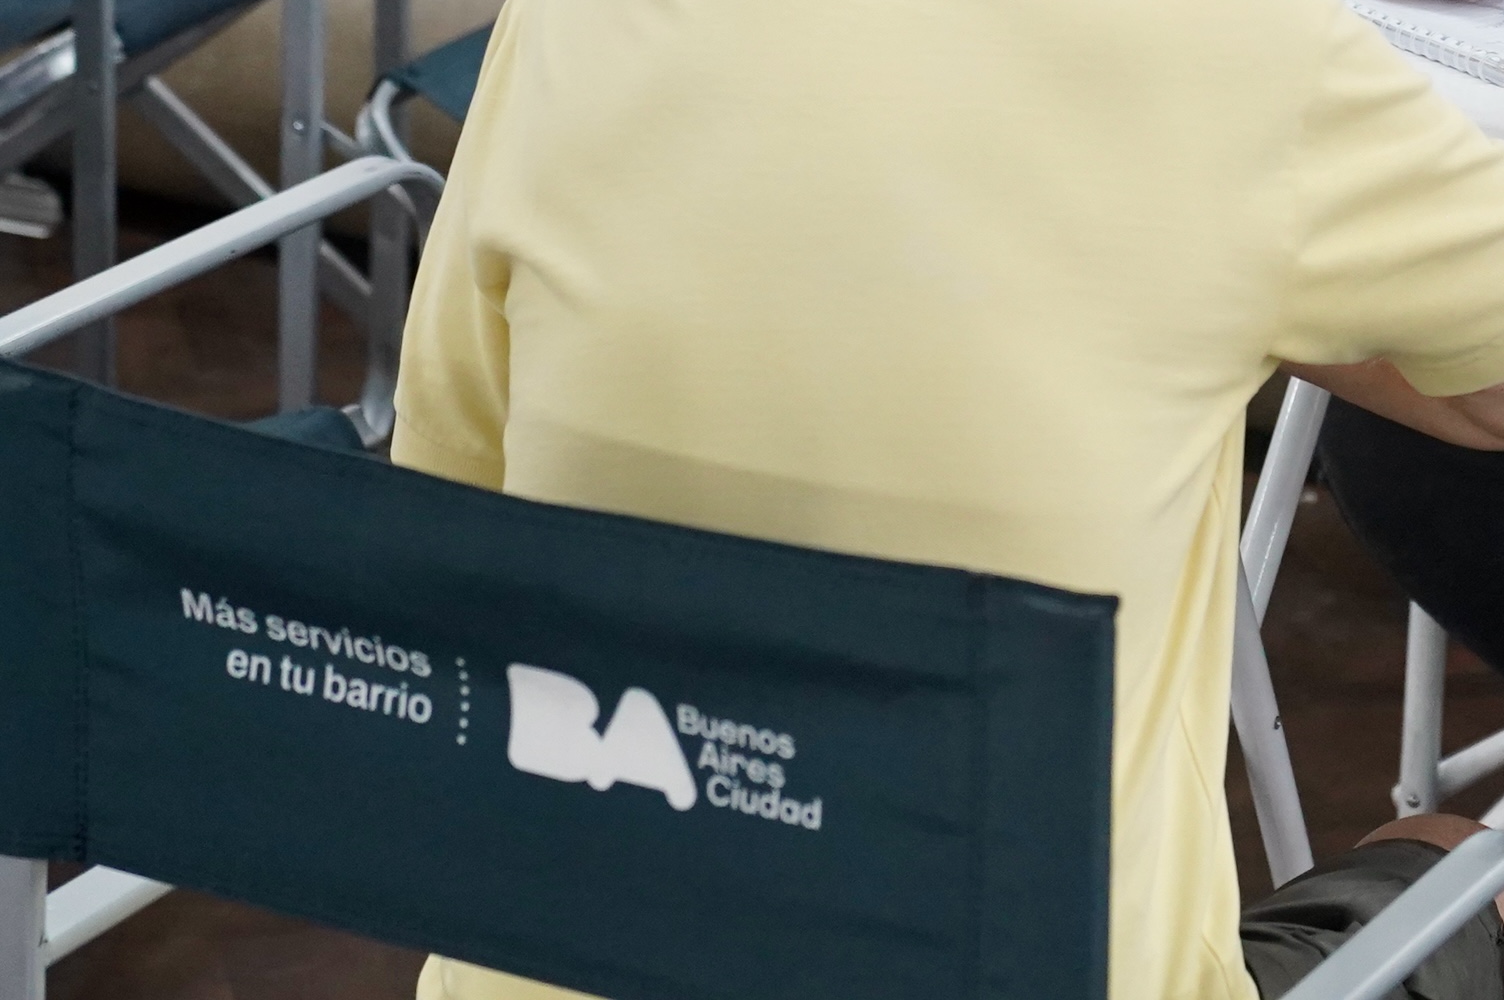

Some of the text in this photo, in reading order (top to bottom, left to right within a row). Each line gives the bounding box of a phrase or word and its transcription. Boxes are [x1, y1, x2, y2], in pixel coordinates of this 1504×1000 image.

[180, 588, 432, 678] Más servicios
[226, 646, 433, 725] en tu barrio
[506, 662, 698, 812] BA
[675, 702, 797, 761] Buenos
[697, 741, 786, 789] Aires
[704, 774, 823, 831] Ciudad
